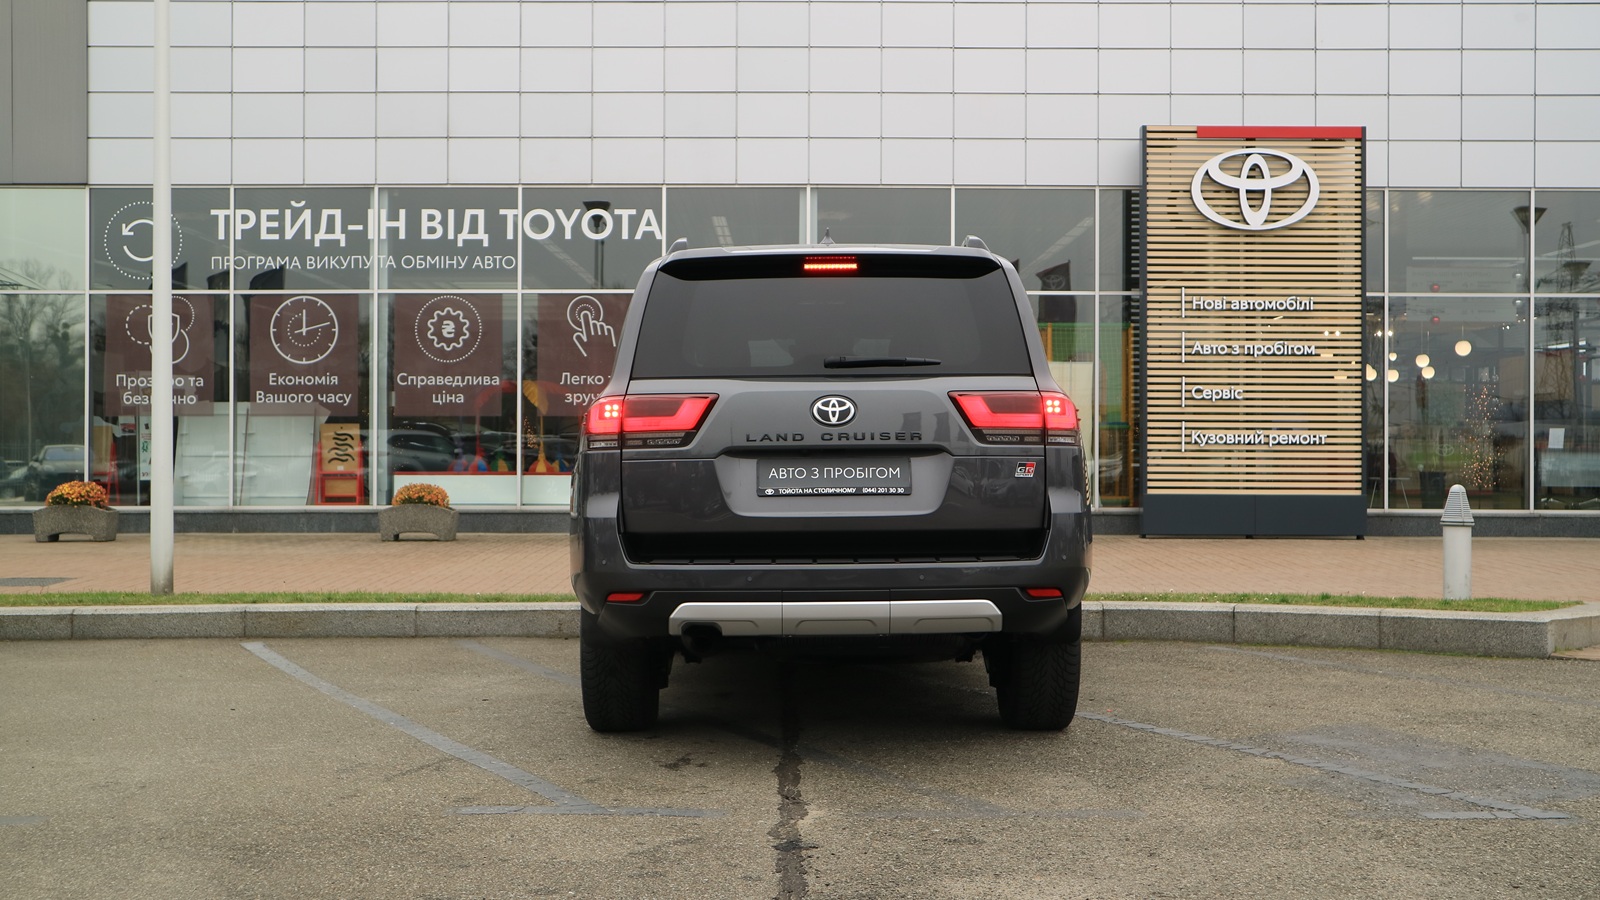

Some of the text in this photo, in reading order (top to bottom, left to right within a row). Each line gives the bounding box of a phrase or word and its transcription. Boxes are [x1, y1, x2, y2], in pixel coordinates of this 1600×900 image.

[210, 200, 662, 247] ТРЕЙД-ІН ВІД TOYOTA
[211, 255, 516, 270] ПРОГРАМА ВИКУПУ ТА ОБМІНУ АВТО
[1192, 296, 1314, 311] Нові автомобілі
[1191, 341, 1316, 358] Авто з пробігом
[116, 374, 204, 390] Прозо та
[268, 372, 339, 386] Економія
[396, 372, 500, 389] Справедлива
[560, 372, 604, 385] Легко
[256, 390, 352, 406] Вашого часу
[432, 390, 465, 406] ціна
[1191, 386, 1244, 402] Сервіс
[745, 431, 923, 443] LAND CRUISER
[1191, 430, 1328, 448] Кузовний ремонт
[768, 467, 901, 479] АВТО З ПРОБІГОМ
[1017, 466, 1035, 474] GR
